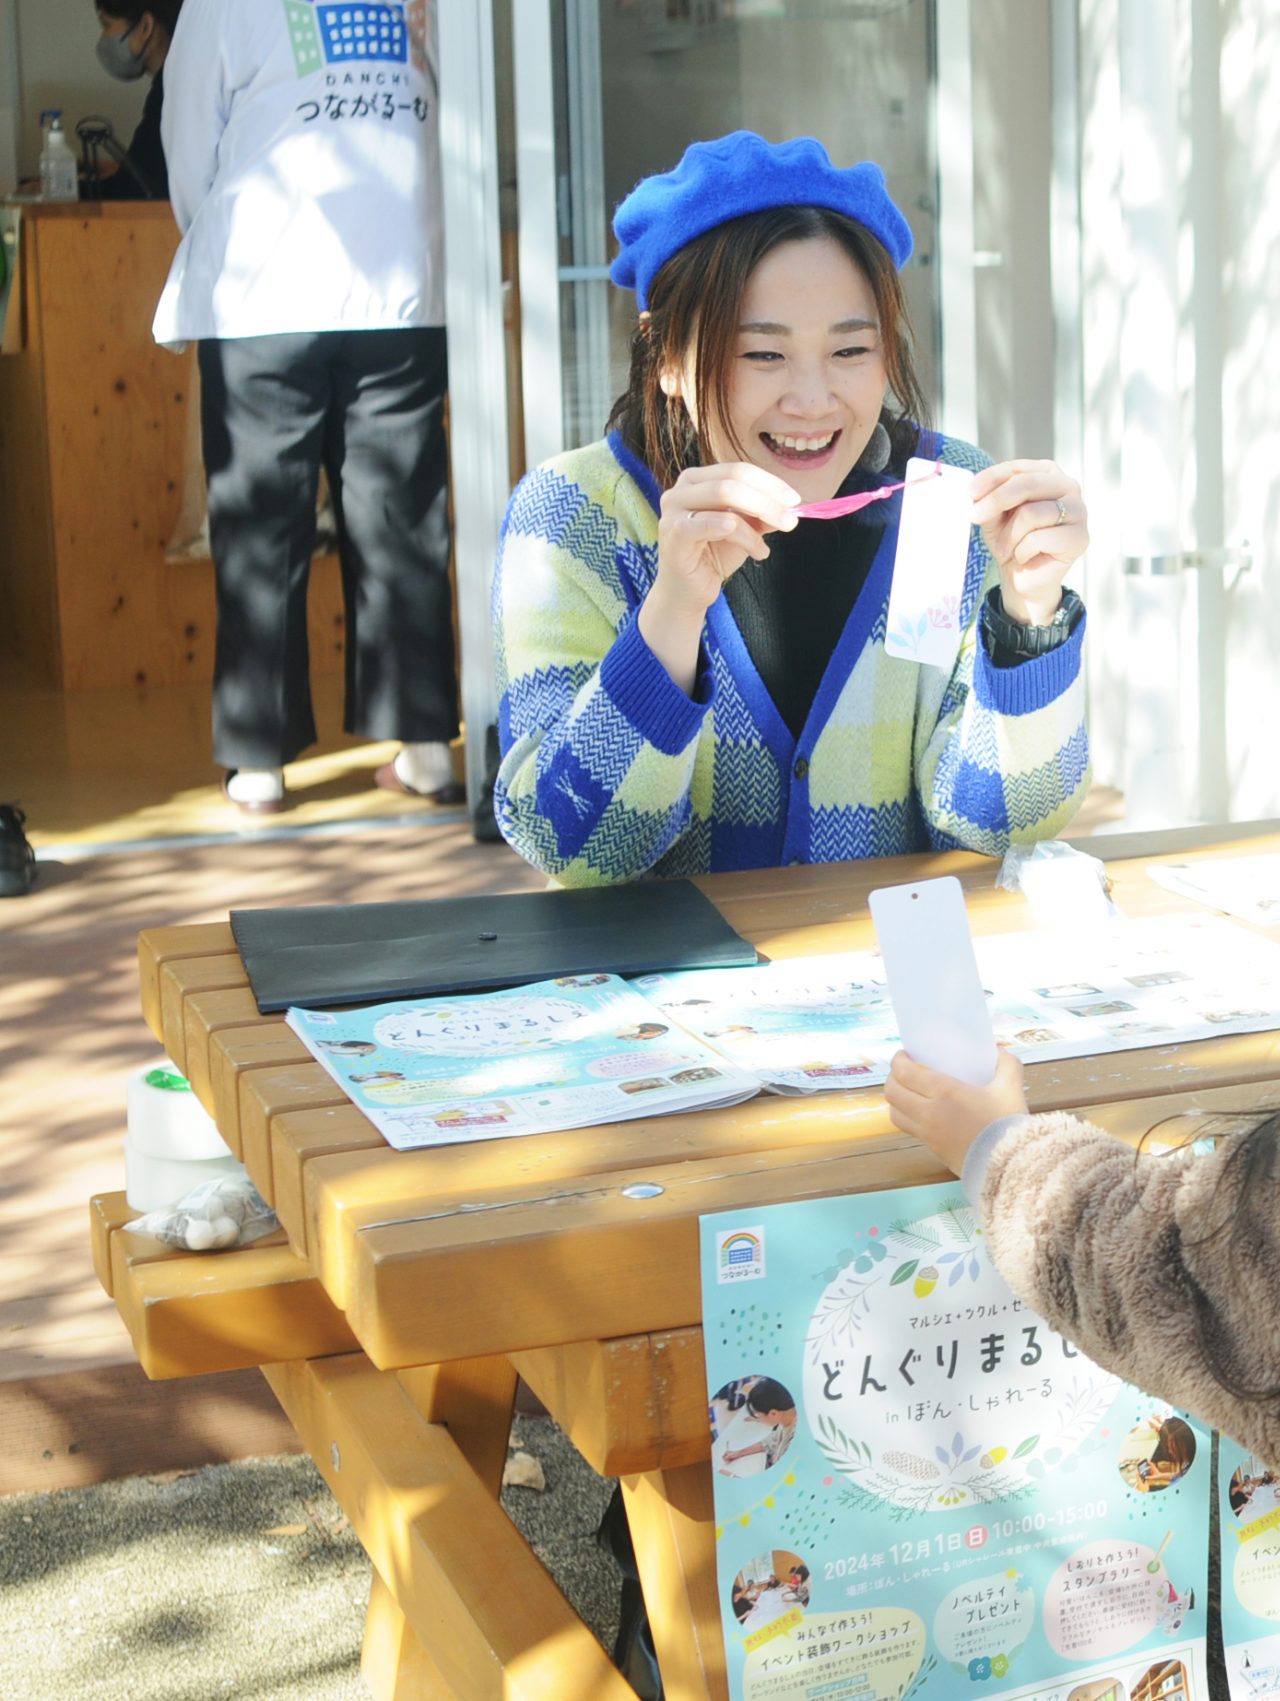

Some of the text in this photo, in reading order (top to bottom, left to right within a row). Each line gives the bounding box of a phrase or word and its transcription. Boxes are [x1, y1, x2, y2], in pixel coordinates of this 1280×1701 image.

[296, 92, 428, 121] つながるーむ
[886, 1412, 899, 1425] in
[823, 1499, 1109, 1581] 2024年 12月1日 日 10:00-15:00
[1063, 1566, 1141, 1593] スタンプラリー
[952, 1586, 1006, 1610] ノベルティ
[966, 1598, 1021, 1625] プレゼント
[761, 1620, 912, 1672] イベント装飾ワークショップ
